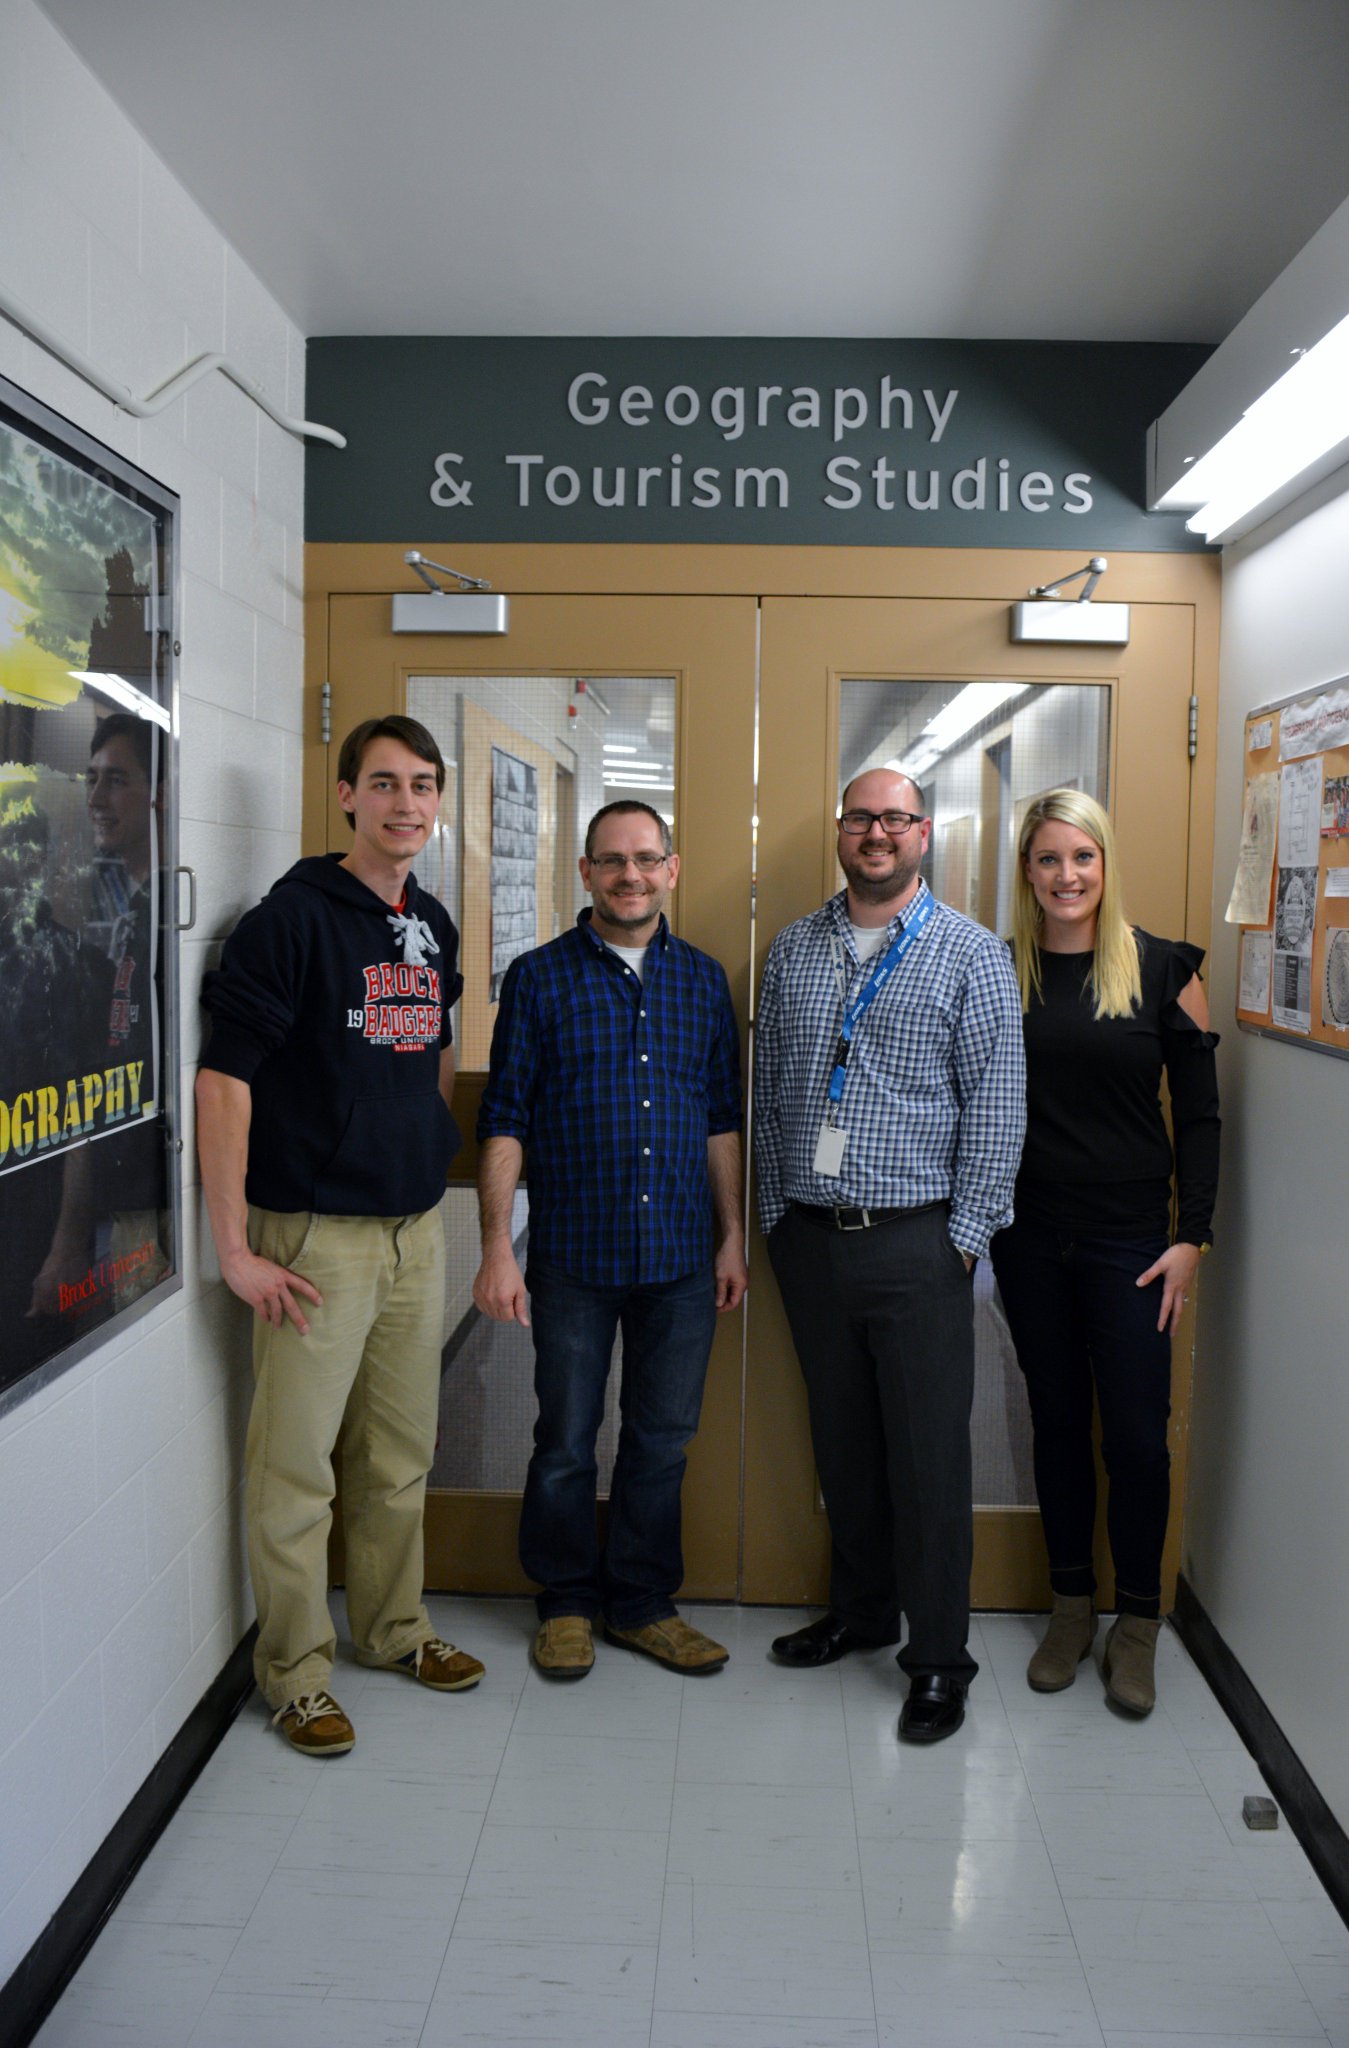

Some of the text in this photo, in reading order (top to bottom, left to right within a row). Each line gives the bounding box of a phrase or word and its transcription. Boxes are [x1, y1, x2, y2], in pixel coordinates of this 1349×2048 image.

[567, 372, 960, 442] Geography
[429, 452, 1094, 514] & Tourism Studies
[362, 962, 442, 1004] BROCK
[346, 1004, 442, 1037] 19 BADGERS
[370, 1037, 397, 1045] BROCK
[58, 1267, 97, 1312] Brock
